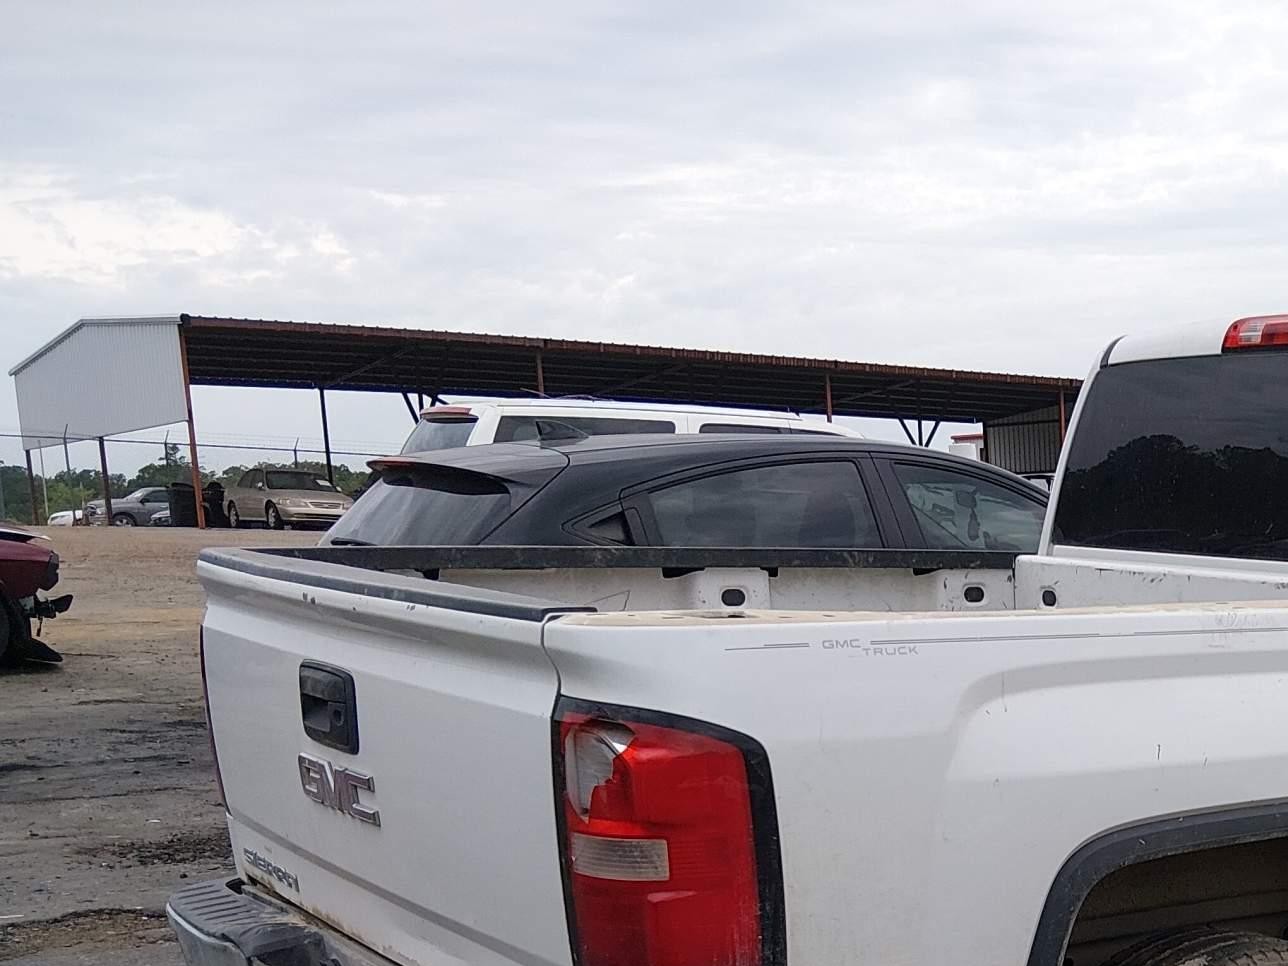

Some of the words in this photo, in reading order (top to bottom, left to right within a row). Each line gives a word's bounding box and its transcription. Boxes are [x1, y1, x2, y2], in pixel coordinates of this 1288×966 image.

[822, 638, 861, 650] GMC
[862, 646, 918, 656] TRUCK
[298, 752, 381, 827] GMC
[243, 847, 300, 893] SIERRA
